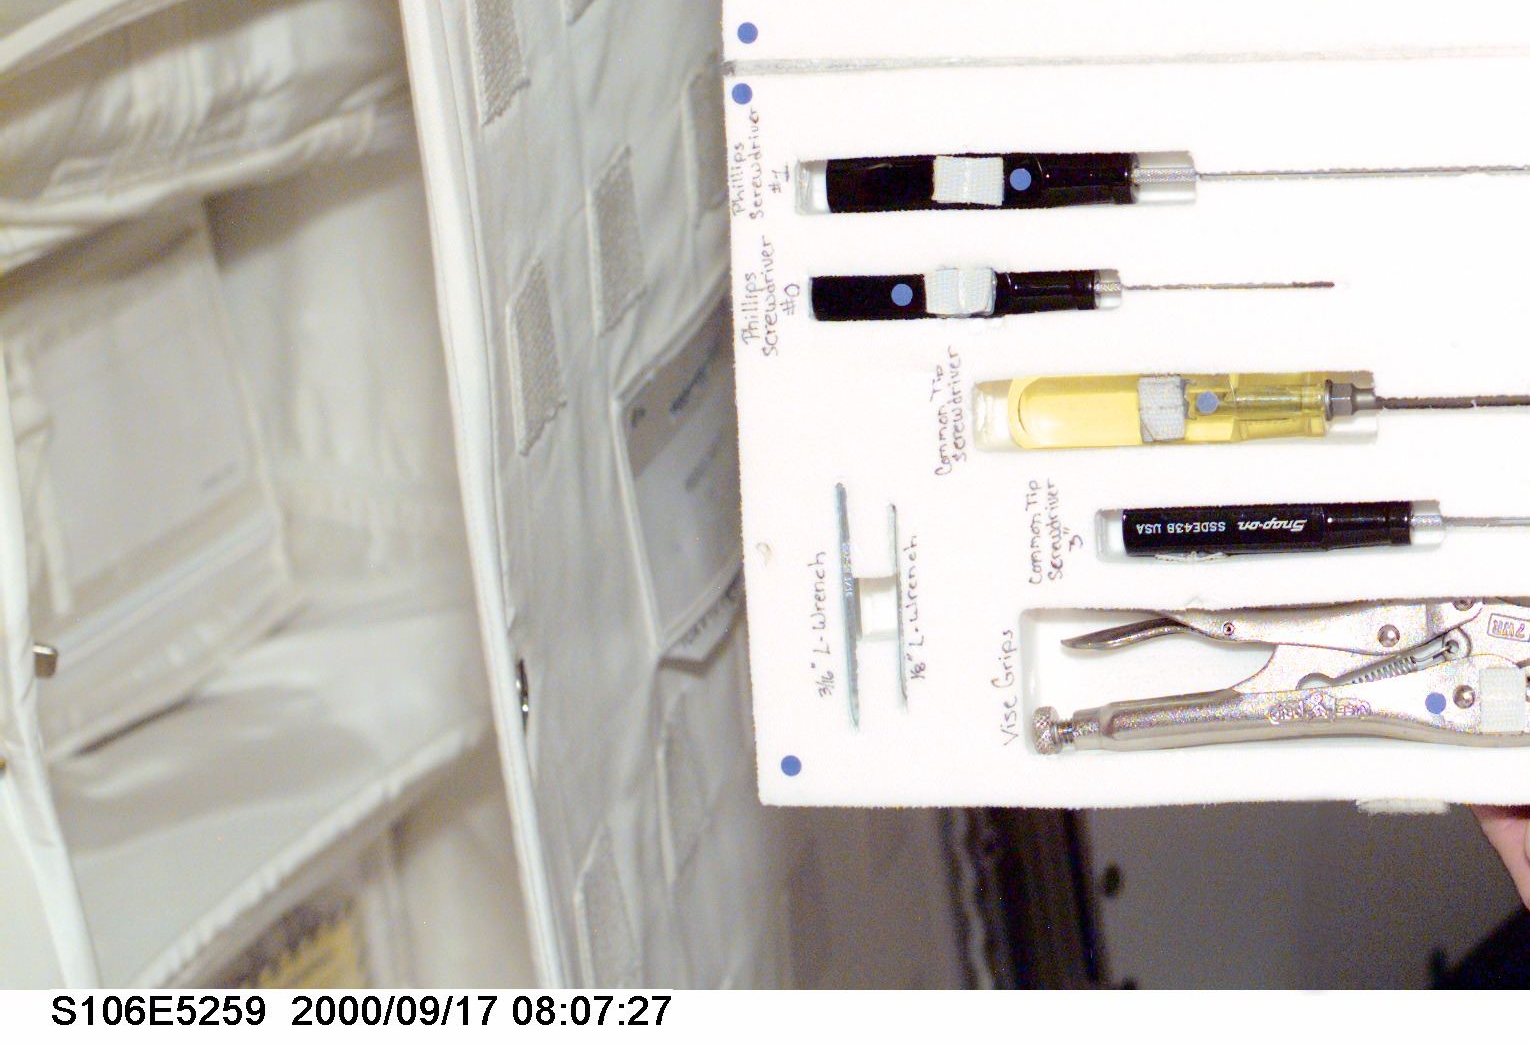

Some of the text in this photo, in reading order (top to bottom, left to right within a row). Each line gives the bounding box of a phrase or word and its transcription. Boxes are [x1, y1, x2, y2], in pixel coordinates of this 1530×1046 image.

[731, 142, 746, 217] Phillips
[747, 108, 764, 220] Screwdriver
[741, 271, 760, 346] Phillips
[759, 234, 779, 358] Screwdriver
[929, 365, 952, 476] Common Tip
[947, 346, 967, 462] Screwdriver
[1025, 480, 1042, 585] Common Tip
[1044, 477, 1064, 581] Screwdriver
[1136, 522, 1162, 536] USA
[1236, 519, 1308, 534] Snap-on
[990, 629, 1019, 746] Vise Grips
